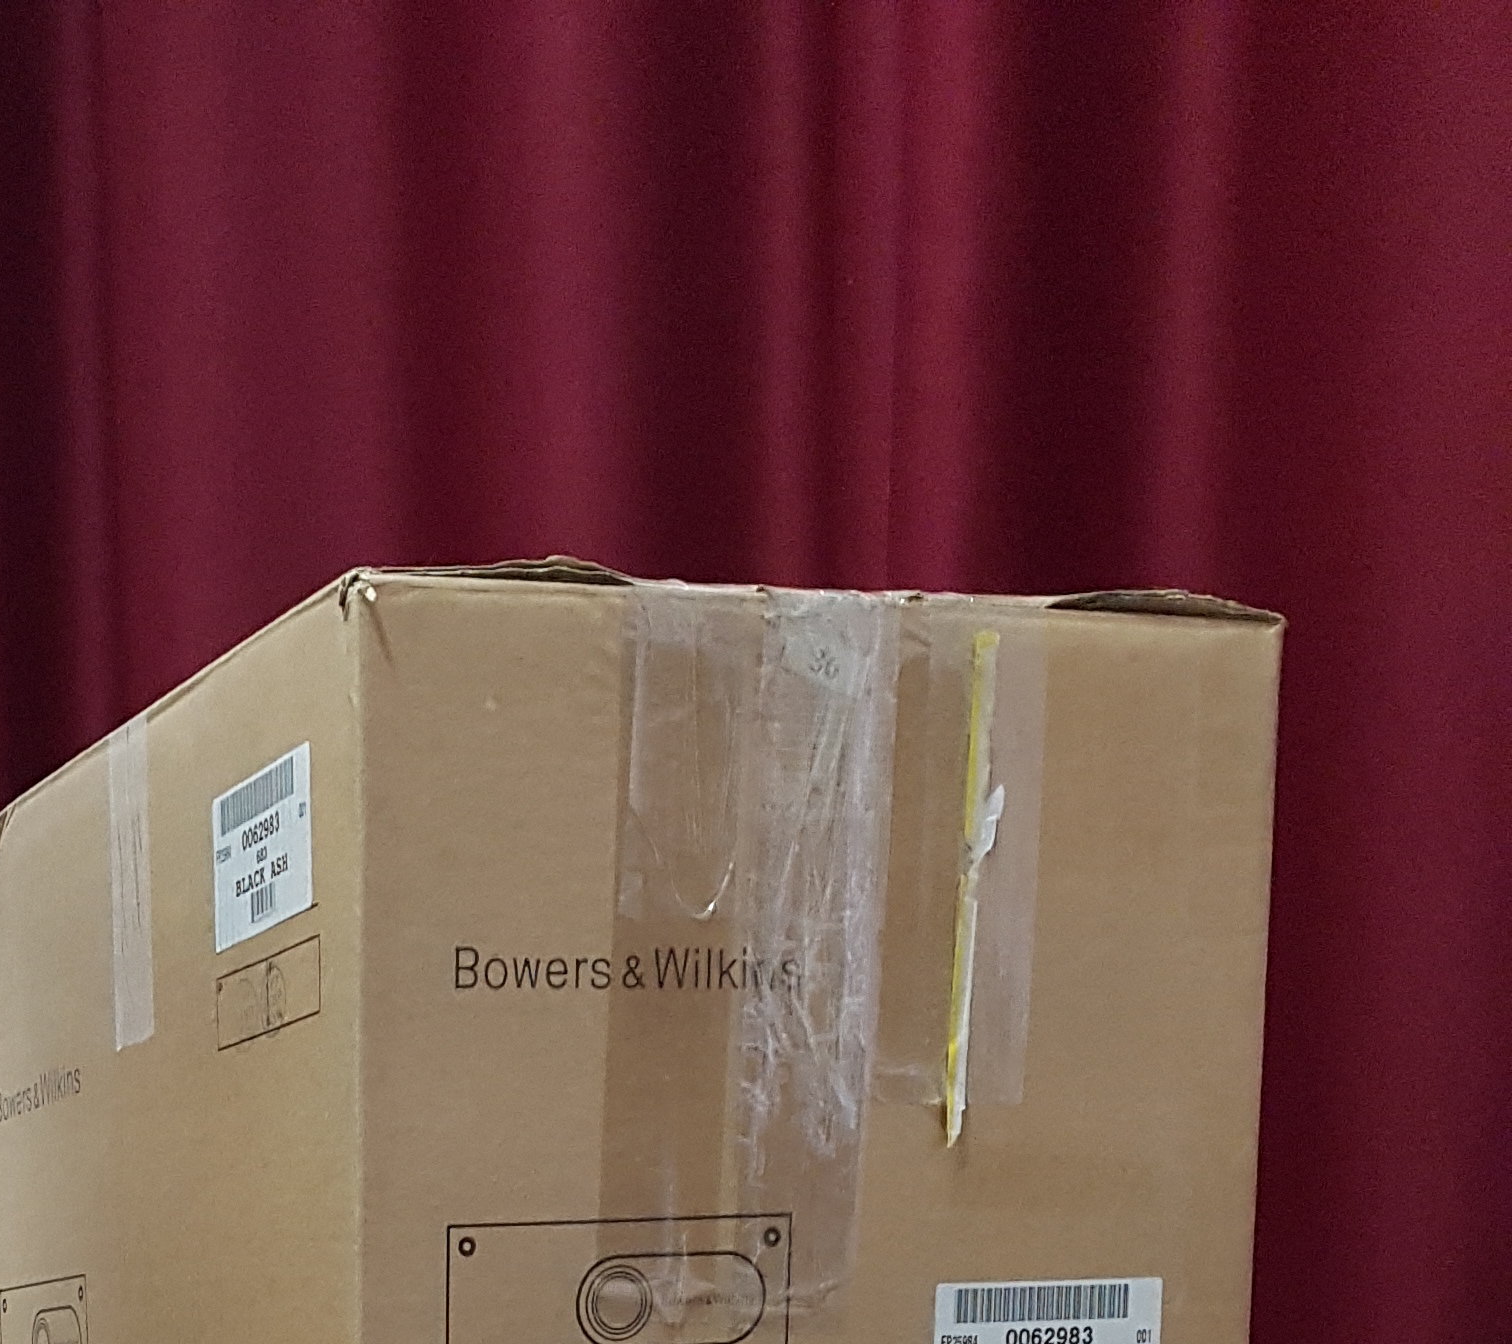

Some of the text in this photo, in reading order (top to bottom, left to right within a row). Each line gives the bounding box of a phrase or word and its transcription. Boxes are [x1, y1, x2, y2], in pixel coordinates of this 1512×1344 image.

[236, 852, 288, 897] BLACK ASH
[455, 945, 612, 990] Bowers
[622, 954, 646, 989] &
